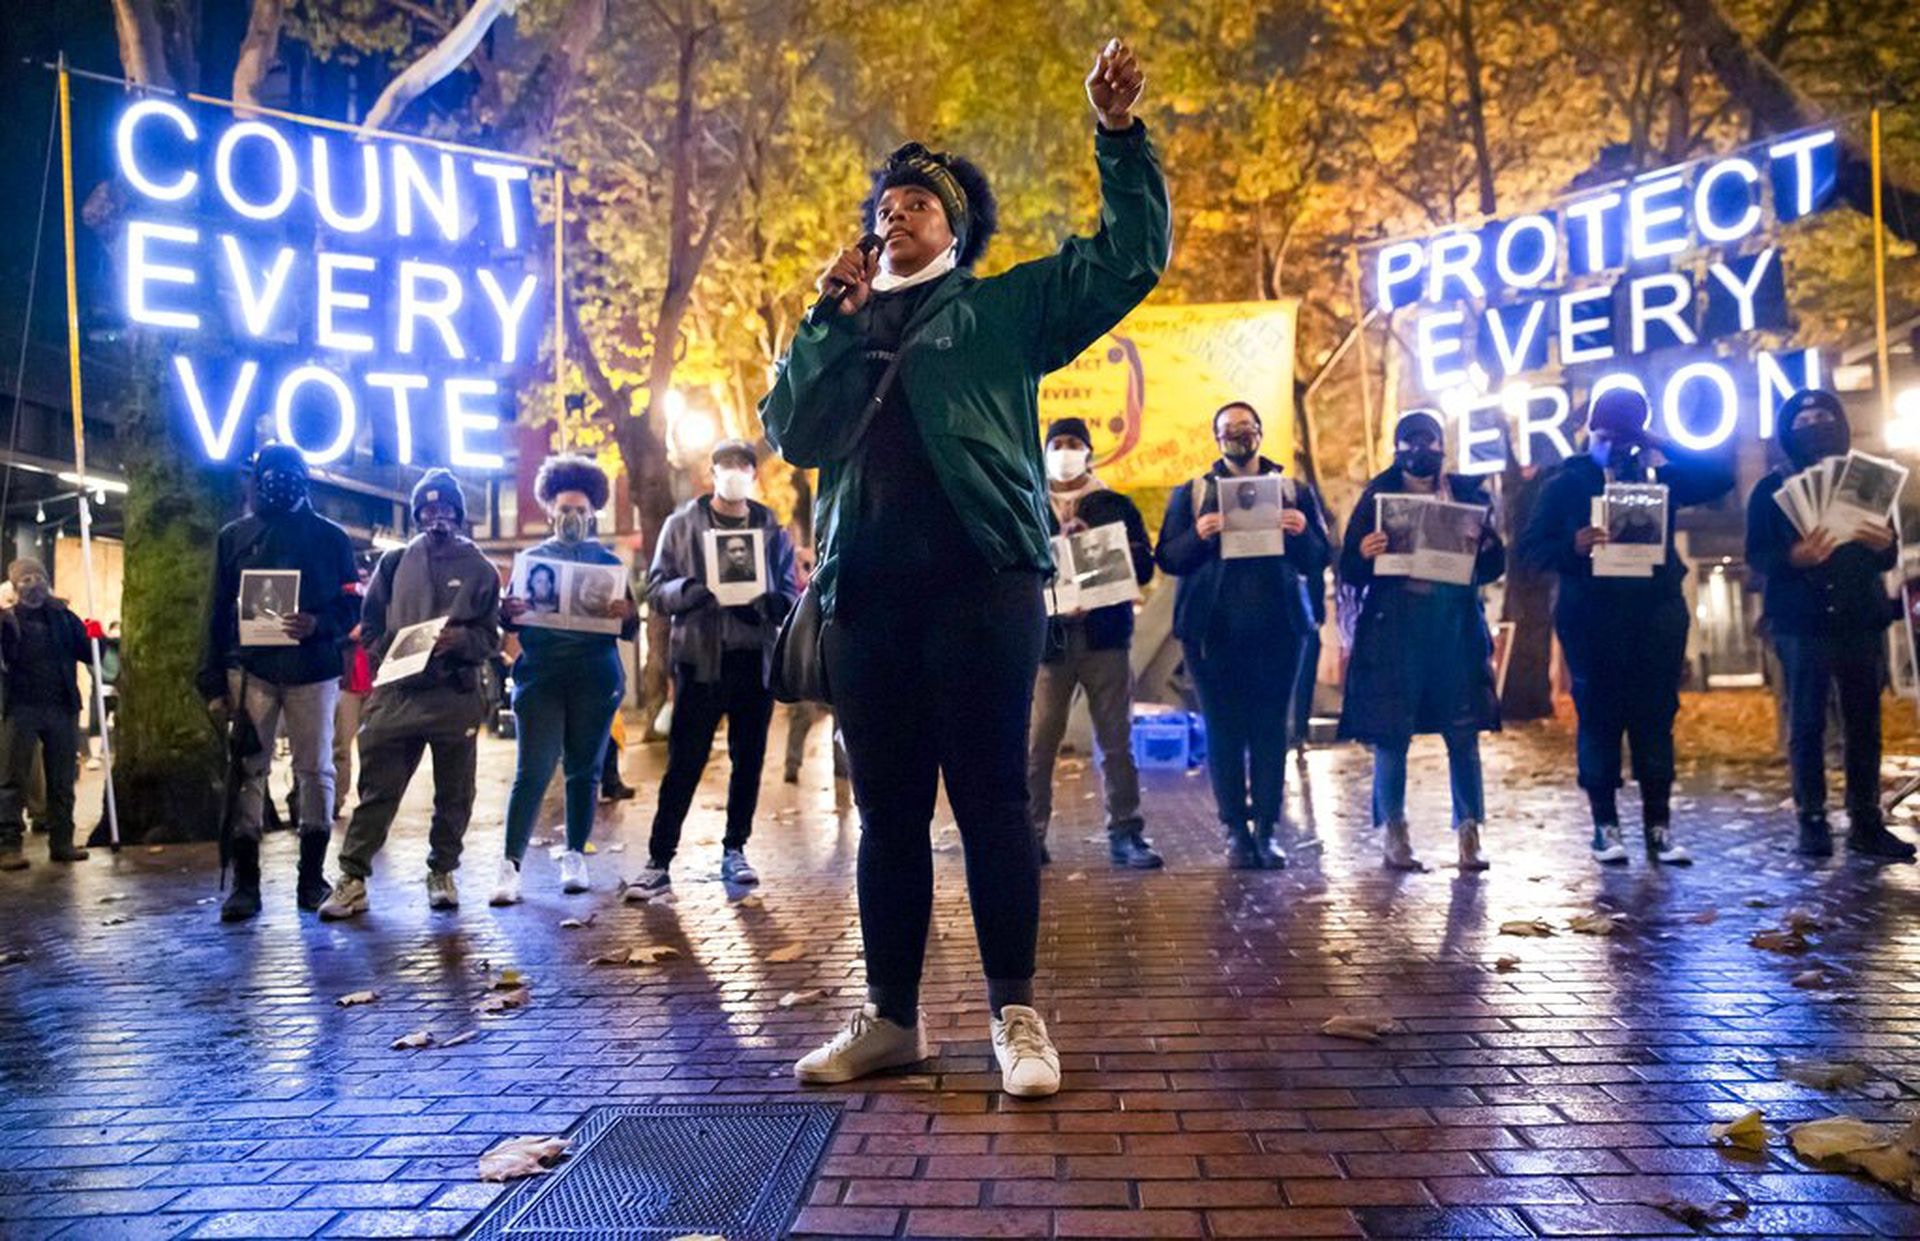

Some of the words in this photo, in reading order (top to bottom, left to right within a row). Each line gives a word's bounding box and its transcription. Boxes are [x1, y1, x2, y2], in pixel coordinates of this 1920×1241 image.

[116, 99, 529, 249] COUNT
[1376, 129, 1837, 313] PROTECT
[125, 220, 539, 363] EVERY
[1415, 247, 1775, 392] EVERY
[173, 354, 504, 470] VOTE
[1041, 387, 1093, 400] EVERY
[1399, 347, 1821, 476] ERON
